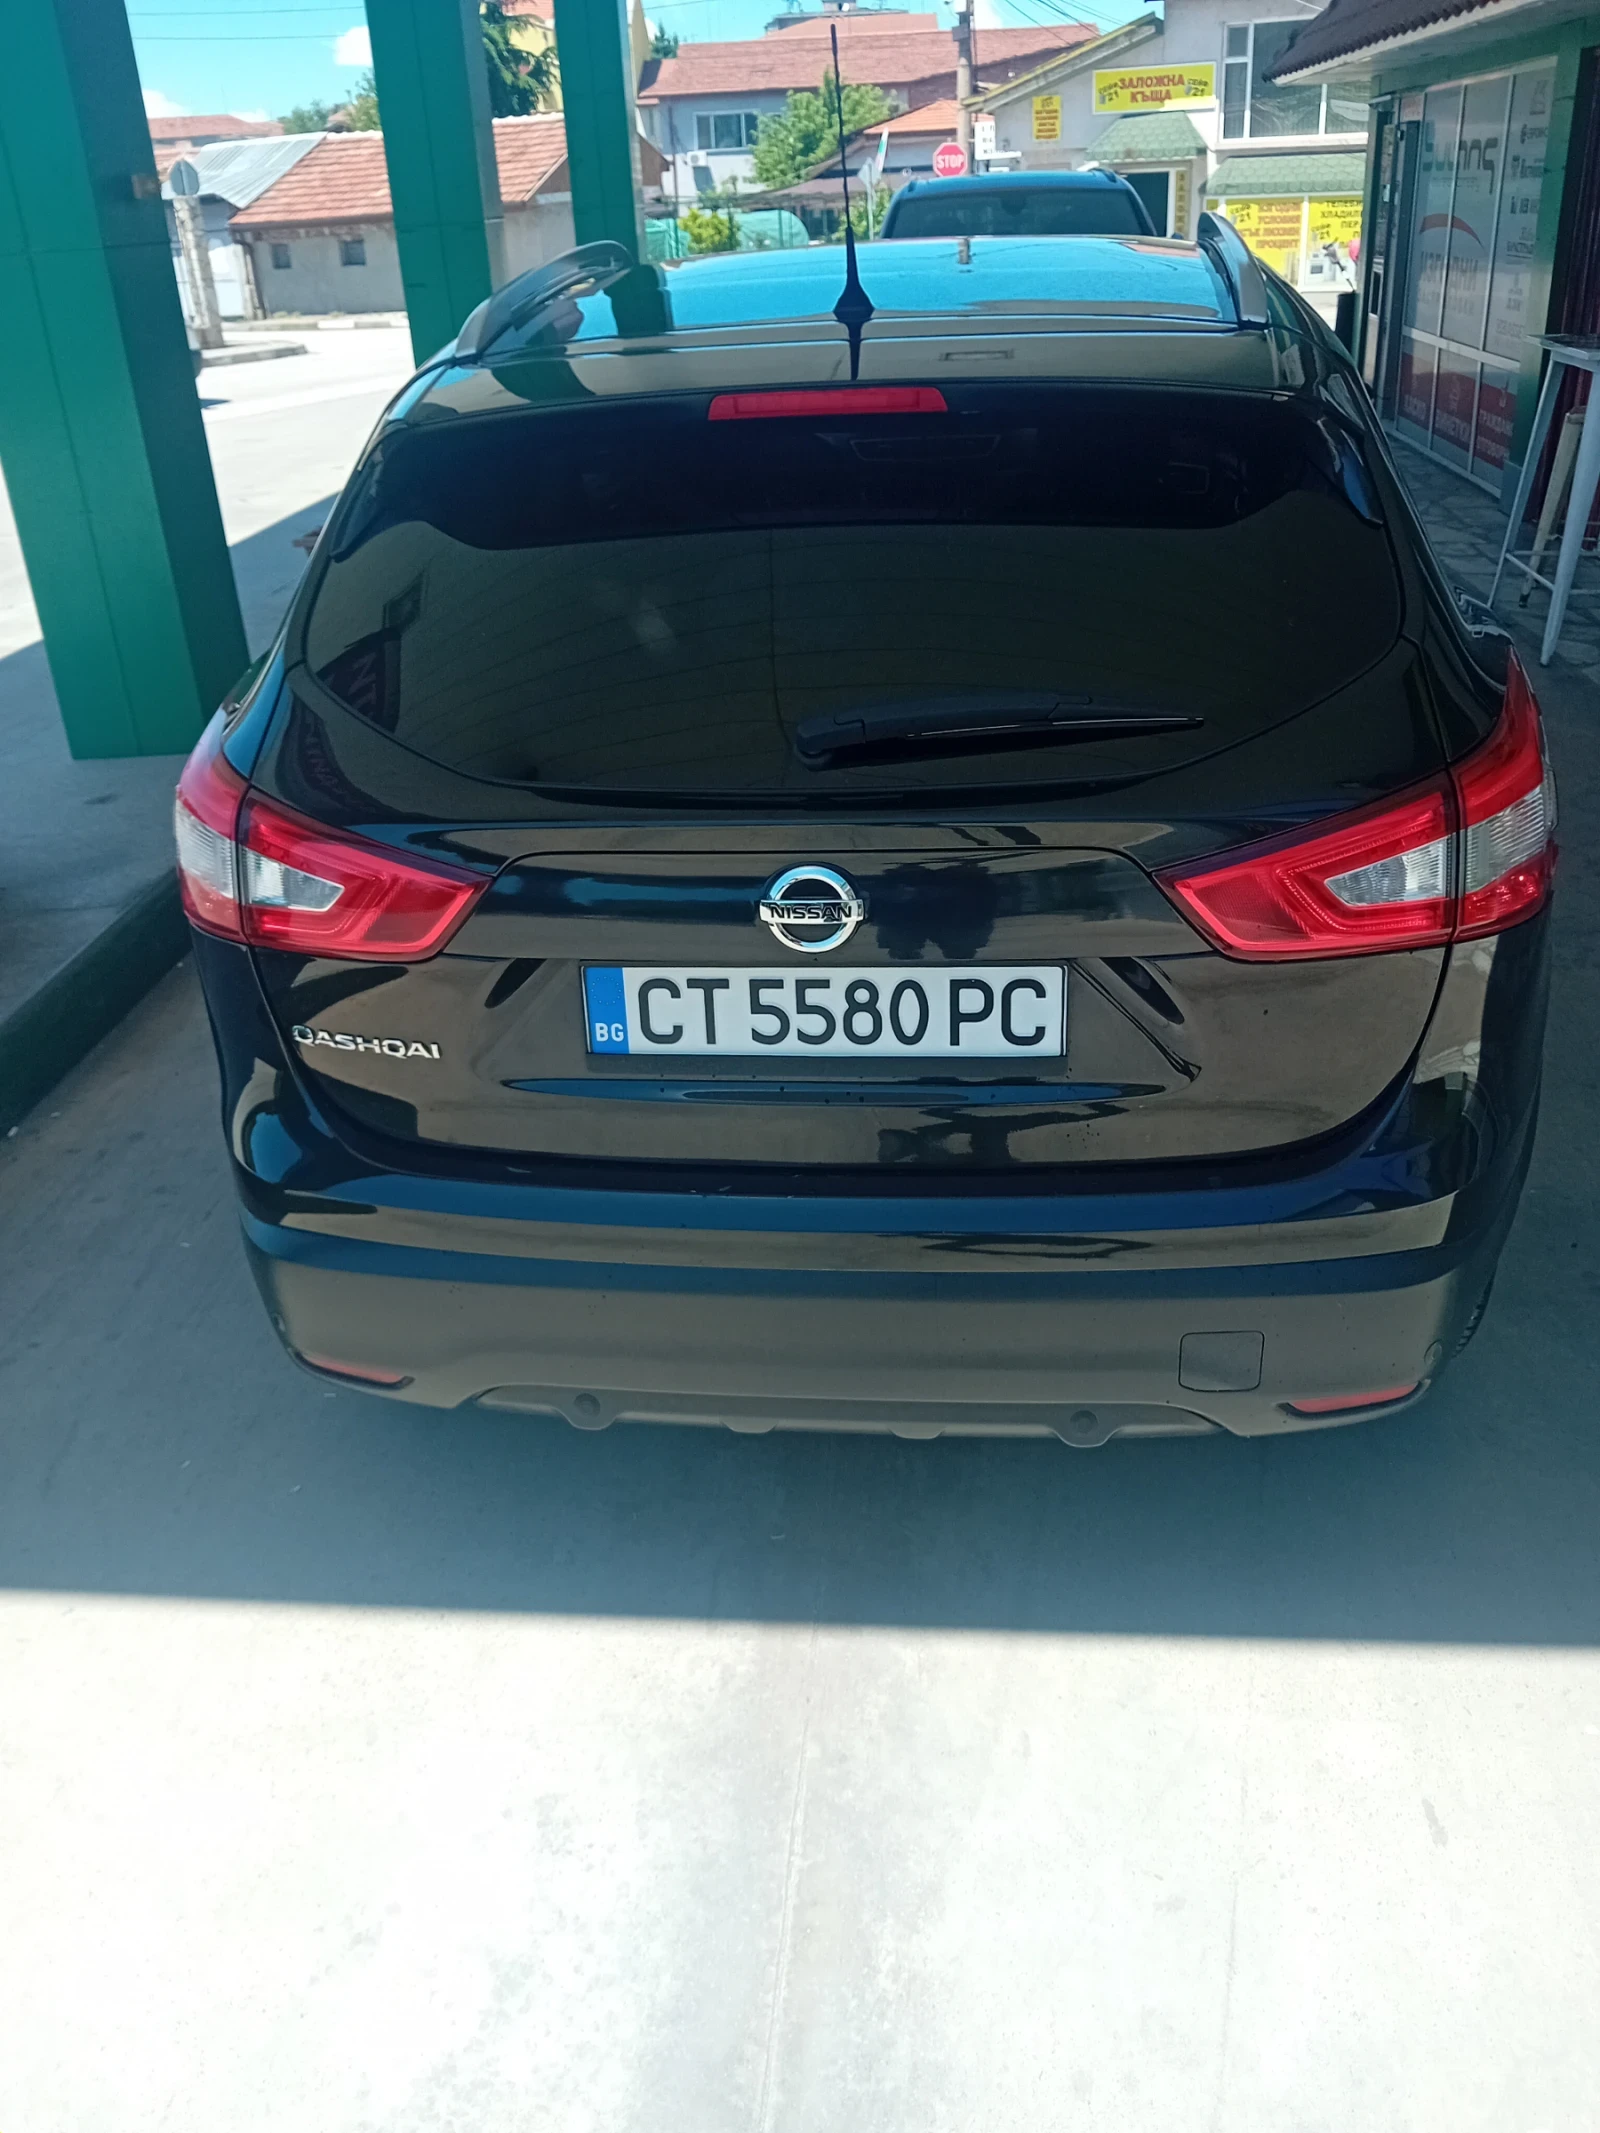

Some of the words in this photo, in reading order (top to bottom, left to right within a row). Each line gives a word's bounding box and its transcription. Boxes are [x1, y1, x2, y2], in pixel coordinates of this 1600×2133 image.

[1119, 74, 1185, 89] ЗАЛОЖНА
[1130, 89, 1172, 103] КЪЩА
[937, 154, 964, 168] STOP
[1320, 210, 1362, 218] ХЛАДИЛ
[770, 904, 852, 921] NISSAN
[638, 978, 730, 1045] CT
[748, 978, 930, 1046] 5580
[949, 978, 1047, 1047] PC
[595, 1023, 624, 1042] BG
[292, 1025, 441, 1060] QASHQAI
